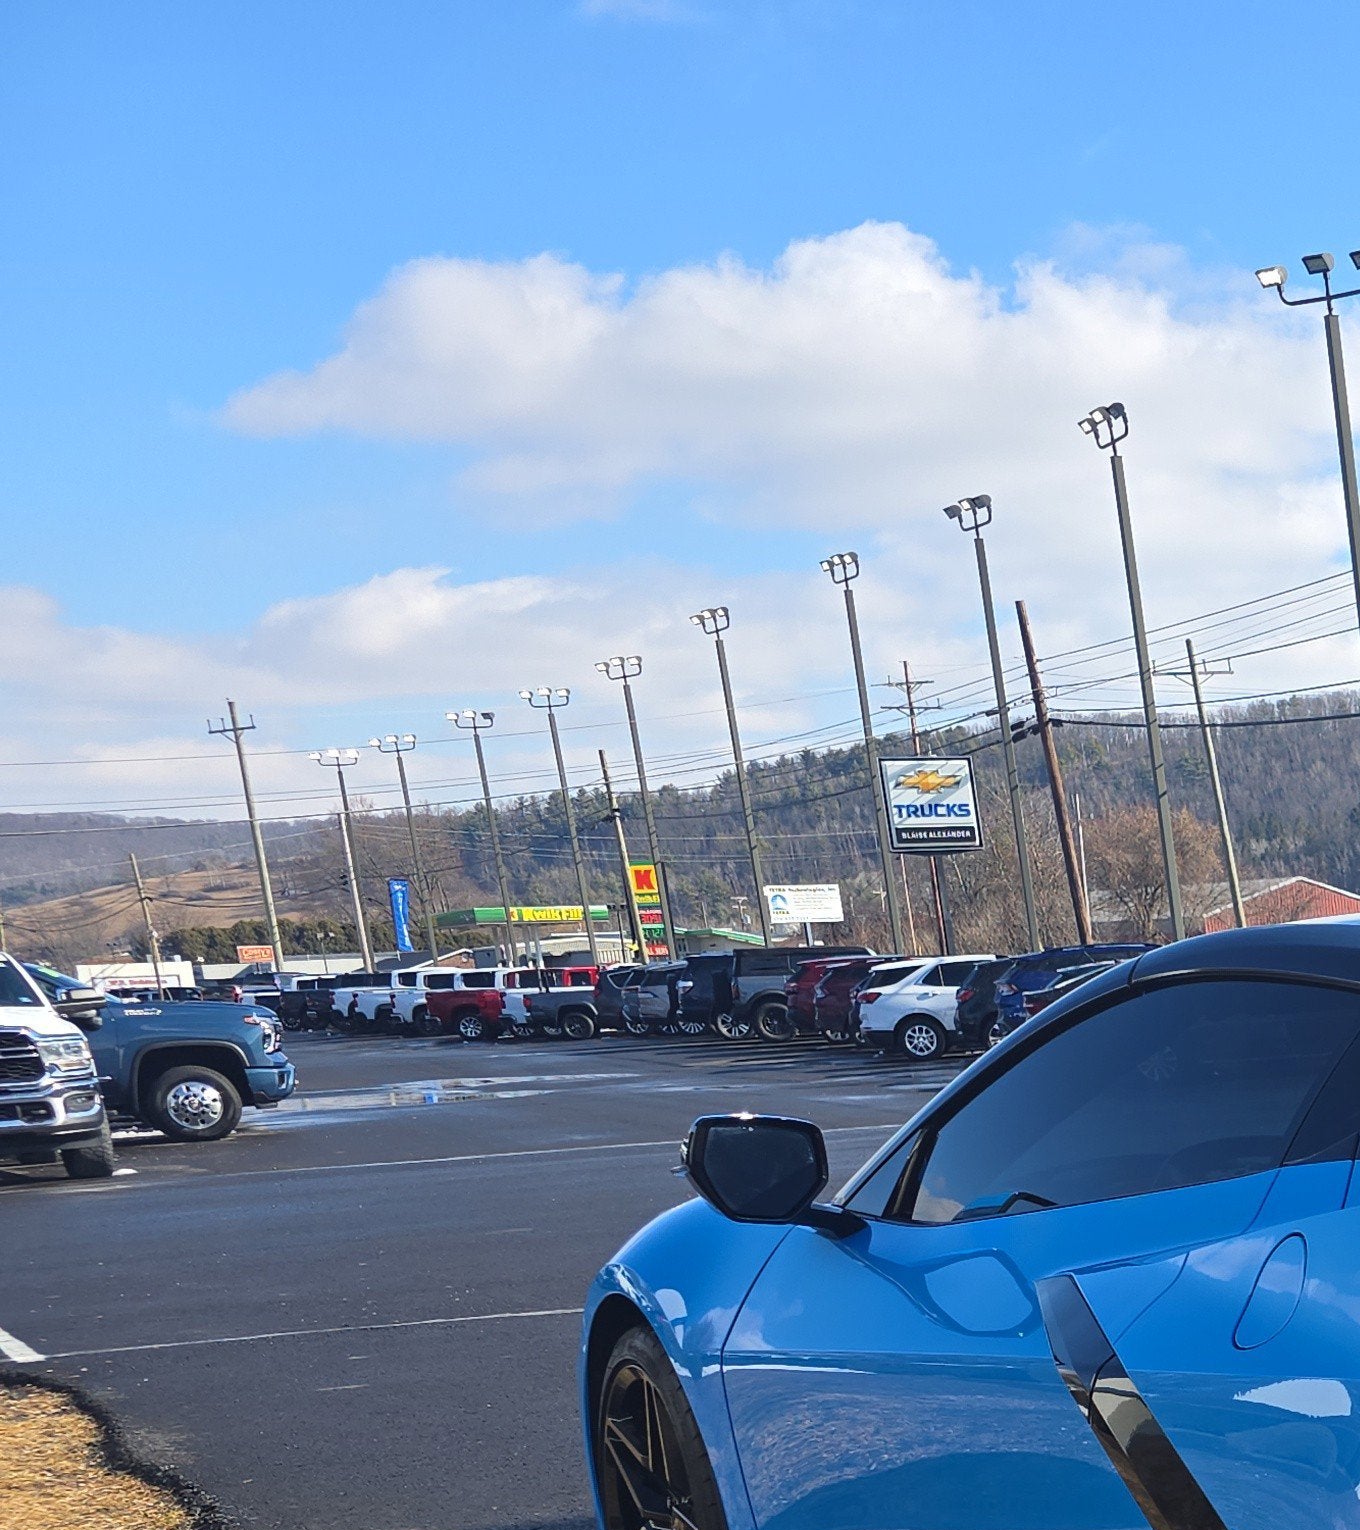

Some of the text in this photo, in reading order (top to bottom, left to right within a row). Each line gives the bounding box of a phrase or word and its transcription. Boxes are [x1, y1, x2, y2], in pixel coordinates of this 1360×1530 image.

[893, 803, 971, 818] TRUCKS
[902, 830, 971, 839] BLAISE ALEXANDER
[633, 869, 656, 890] K
[523, 908, 561, 920] Kwik
